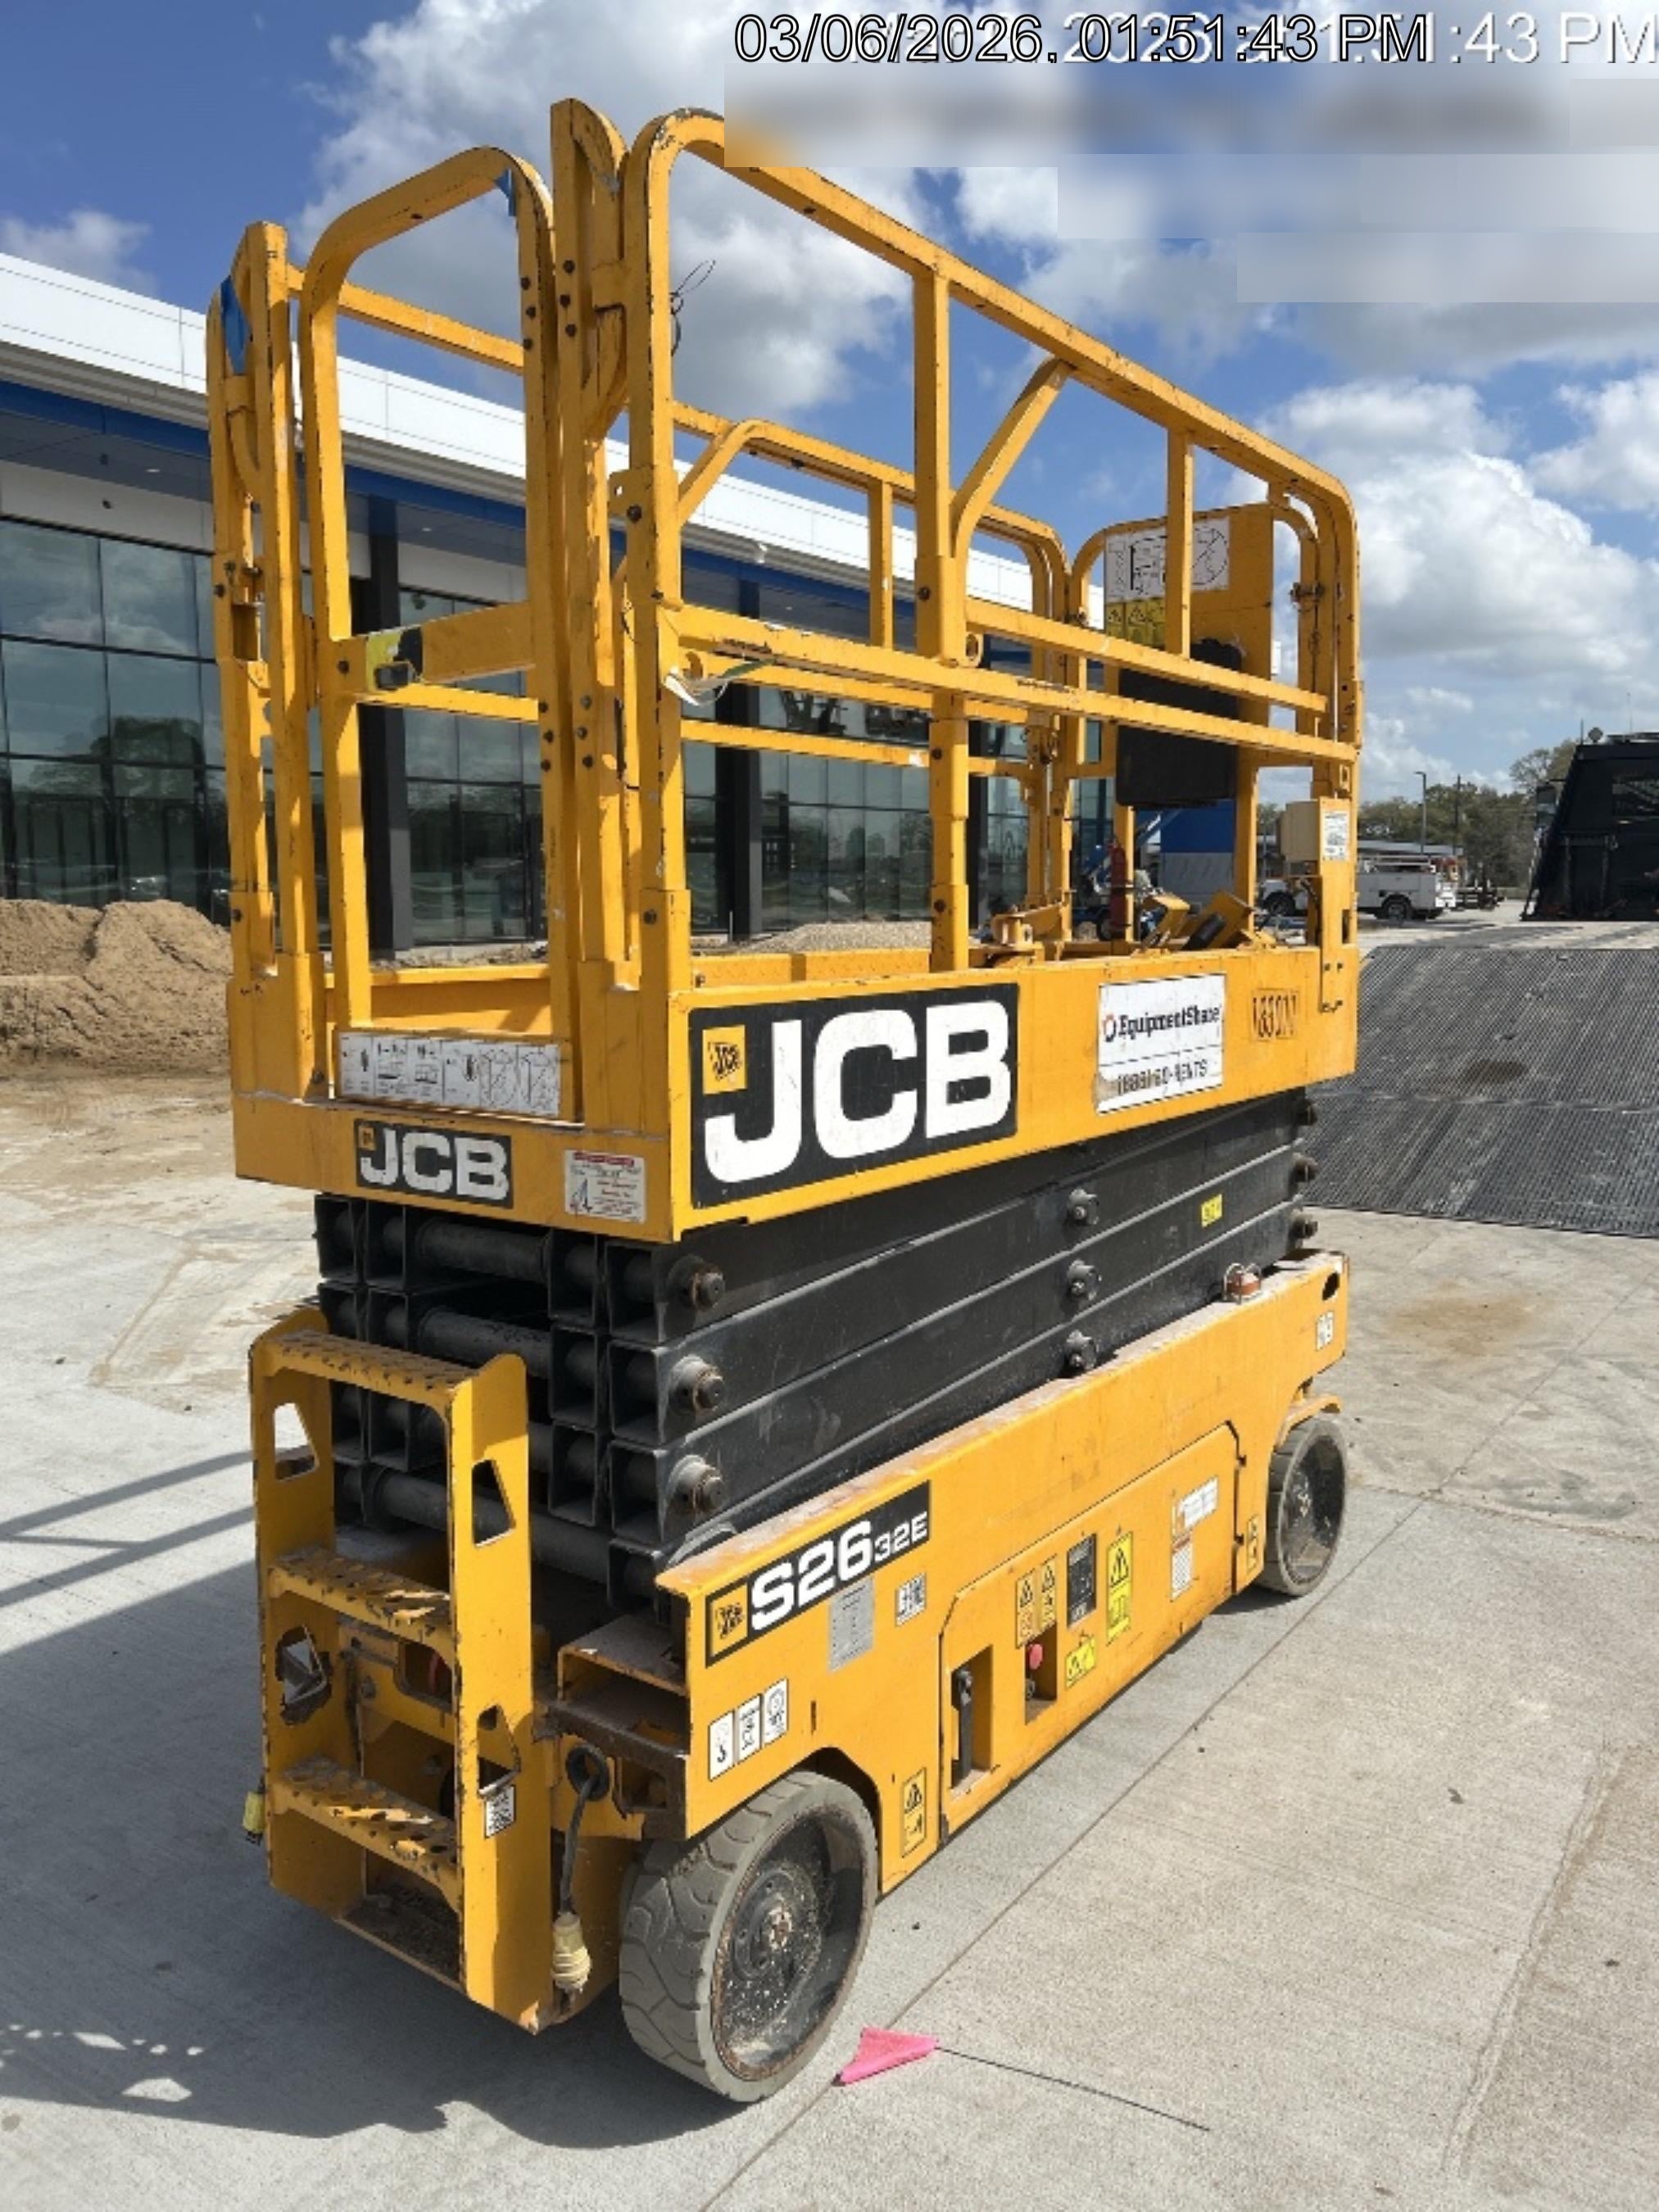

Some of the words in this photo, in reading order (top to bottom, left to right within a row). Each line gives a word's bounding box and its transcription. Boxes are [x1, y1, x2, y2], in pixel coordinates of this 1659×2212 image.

[1118, 1005, 1221, 1040] EquipmentShare
[705, 1001, 1011, 1183] JCB
[360, 1127, 510, 1201] JCB
